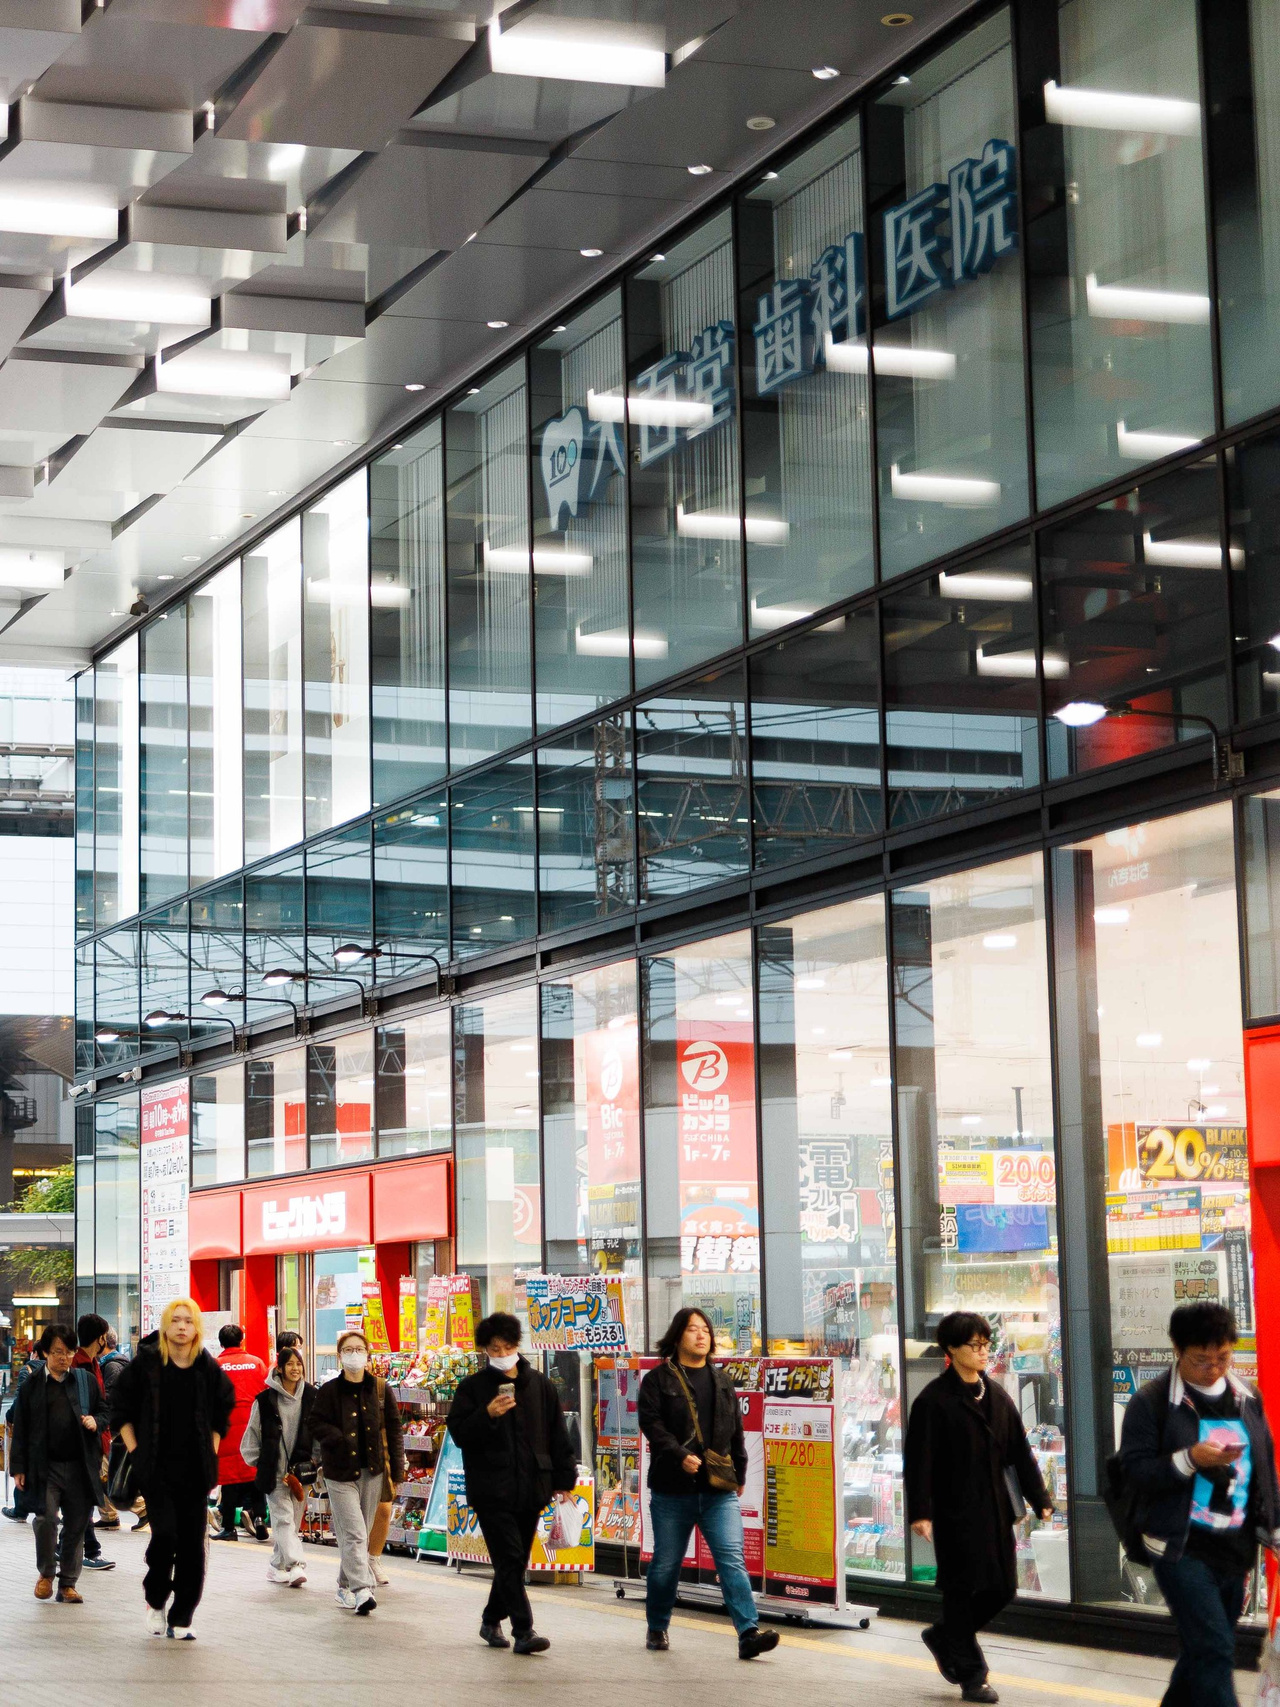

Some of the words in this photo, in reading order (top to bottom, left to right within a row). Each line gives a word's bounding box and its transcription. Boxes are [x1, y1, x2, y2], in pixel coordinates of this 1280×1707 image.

[682, 1093, 730, 1112] ビック
[601, 1103, 623, 1130] Bic
[682, 1114, 730, 1132] カメラ
[1205, 1128, 1245, 1146] BLACK
[1145, 1127, 1226, 1180] 20%
[262, 1191, 346, 1241] ビックカメラ
[684, 1220, 748, 1234] 高く売って
[371, 1319, 383, 1340] 78
[452, 1316, 470, 1338] 181
[738, 1396, 750, 1415] 16
